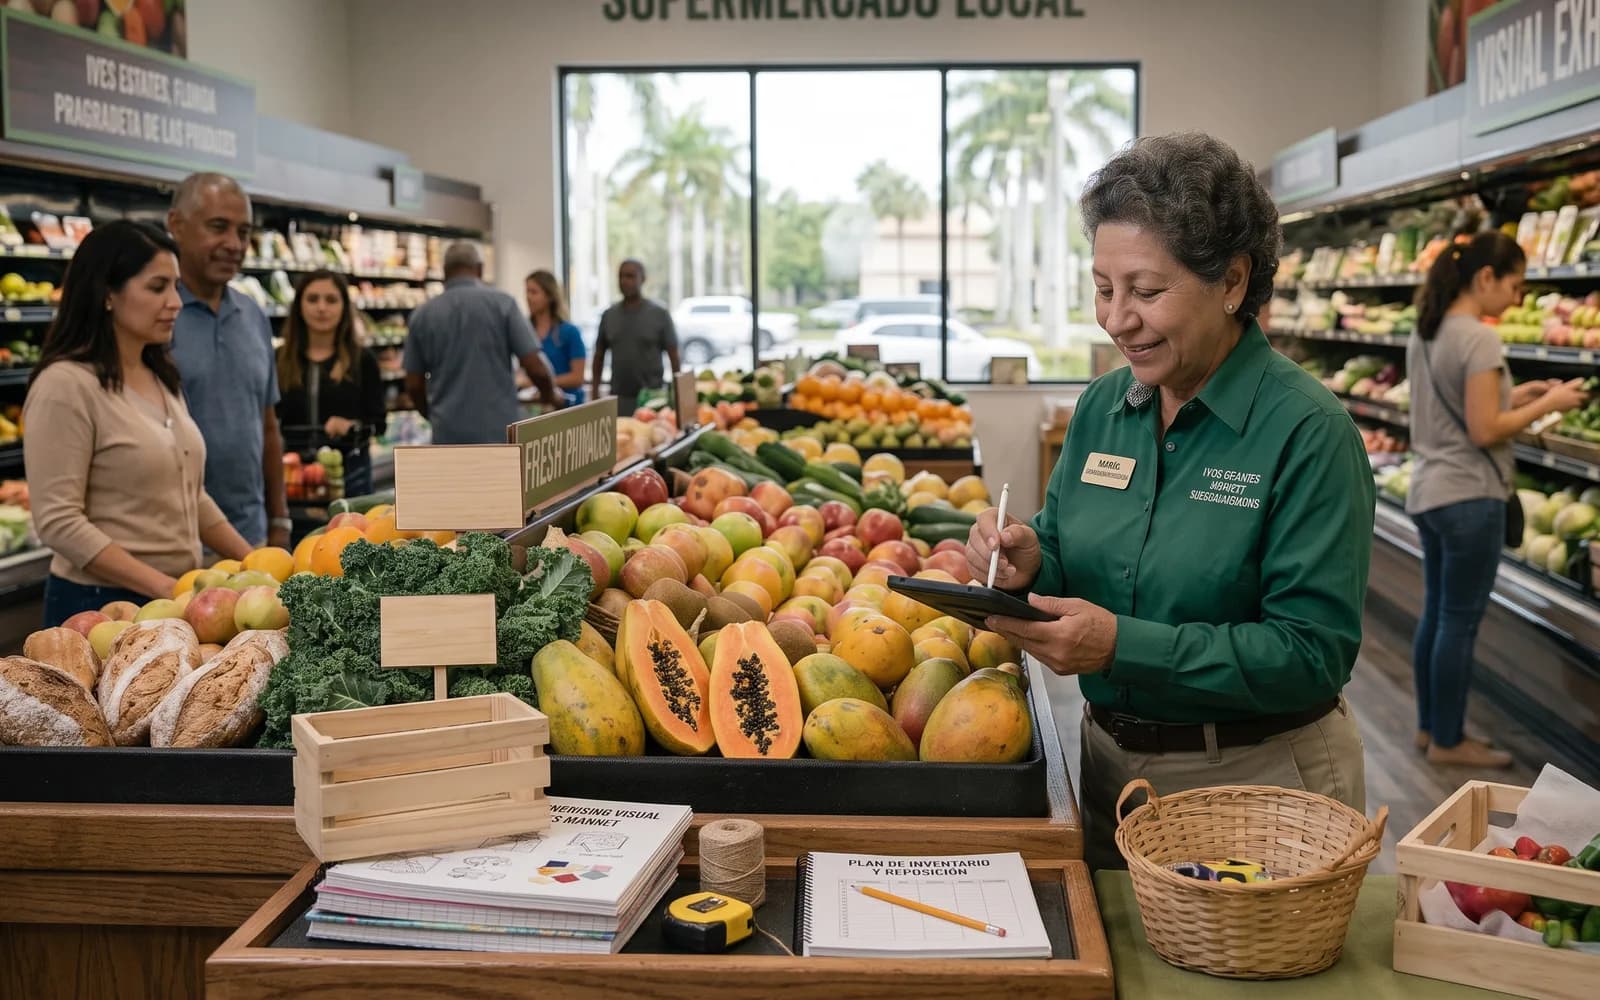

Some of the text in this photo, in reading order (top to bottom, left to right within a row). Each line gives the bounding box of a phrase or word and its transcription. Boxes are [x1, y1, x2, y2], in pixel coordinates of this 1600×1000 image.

[1477, 10, 1547, 107] VISUAL
[525, 432, 563, 493] FRESH
[615, 809, 661, 820] VISUAL
[563, 816, 621, 827] MANNET
[849, 859, 991, 868] PLAN DE INVENTARIO
[872, 867, 968, 876] Y REPOSICIÓN
